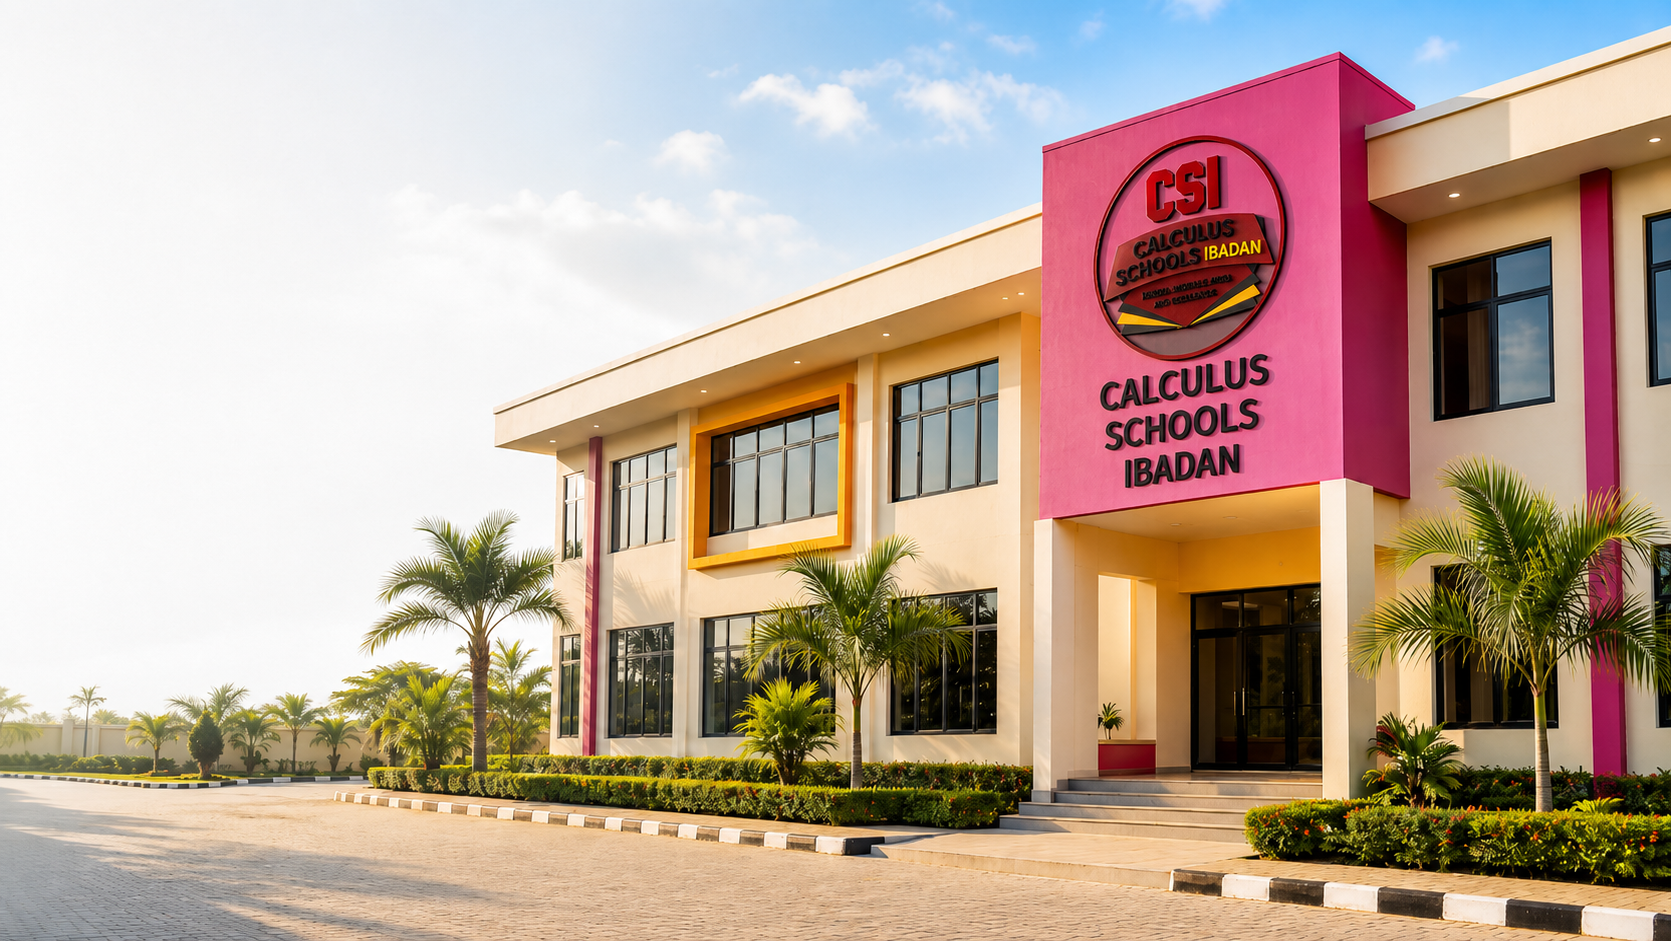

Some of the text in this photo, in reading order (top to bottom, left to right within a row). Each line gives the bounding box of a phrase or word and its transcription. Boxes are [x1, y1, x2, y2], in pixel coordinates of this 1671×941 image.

[1145, 155, 1222, 222] CSI
[1116, 239, 1262, 286] SCHOOLS IBADAN
[1133, 218, 1235, 259] CALCULUS
[1100, 353, 1270, 411] CALCULUS
[1105, 398, 1260, 450] SCHOOLS
[1124, 443, 1241, 488] IBADAN
